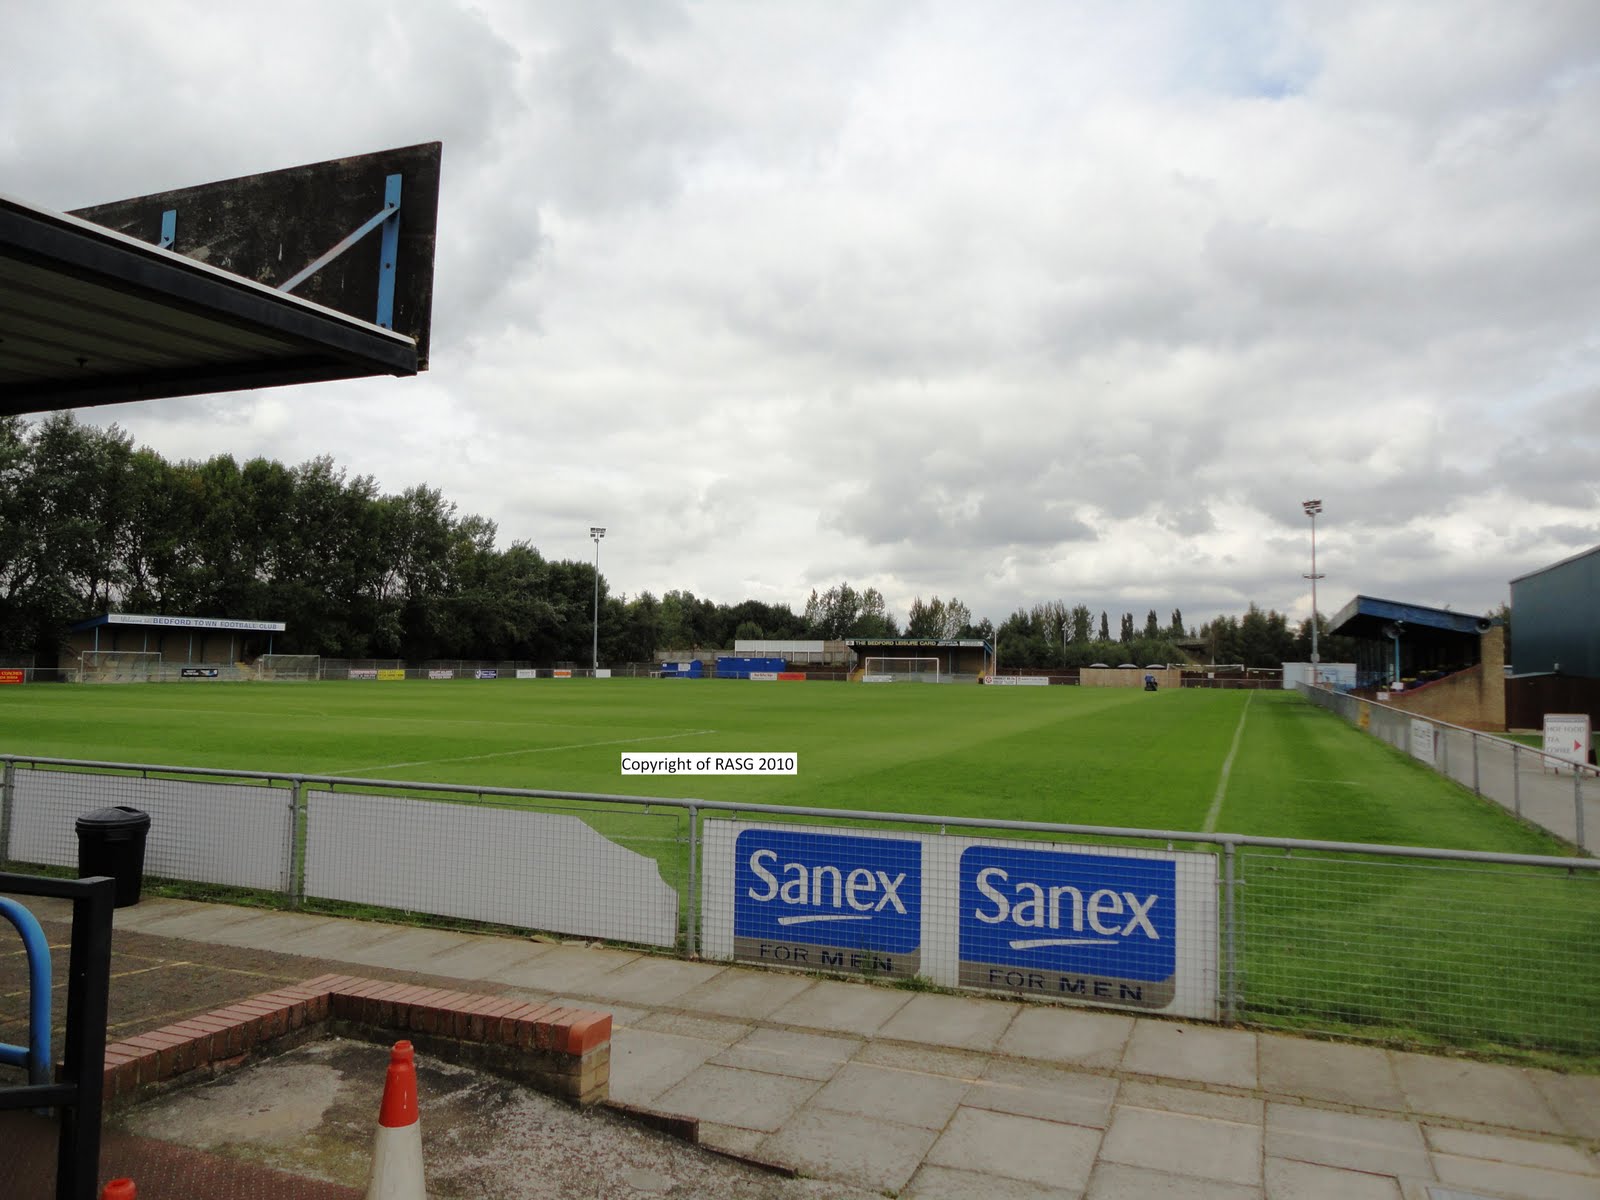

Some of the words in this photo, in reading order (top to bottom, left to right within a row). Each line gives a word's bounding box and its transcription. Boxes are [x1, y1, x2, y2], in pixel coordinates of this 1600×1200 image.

[153, 617, 191, 625] BEDFORD
[194, 619, 217, 627] TOWN
[220, 621, 257, 629] FOOTBALL
[748, 849, 907, 915] Sanex
[975, 867, 1159, 940] Sanex
[759, 944, 809, 964] FOR
[821, 950, 892, 972] MEN
[989, 969, 1045, 991] FOR
[1059, 976, 1142, 1002] MEN
